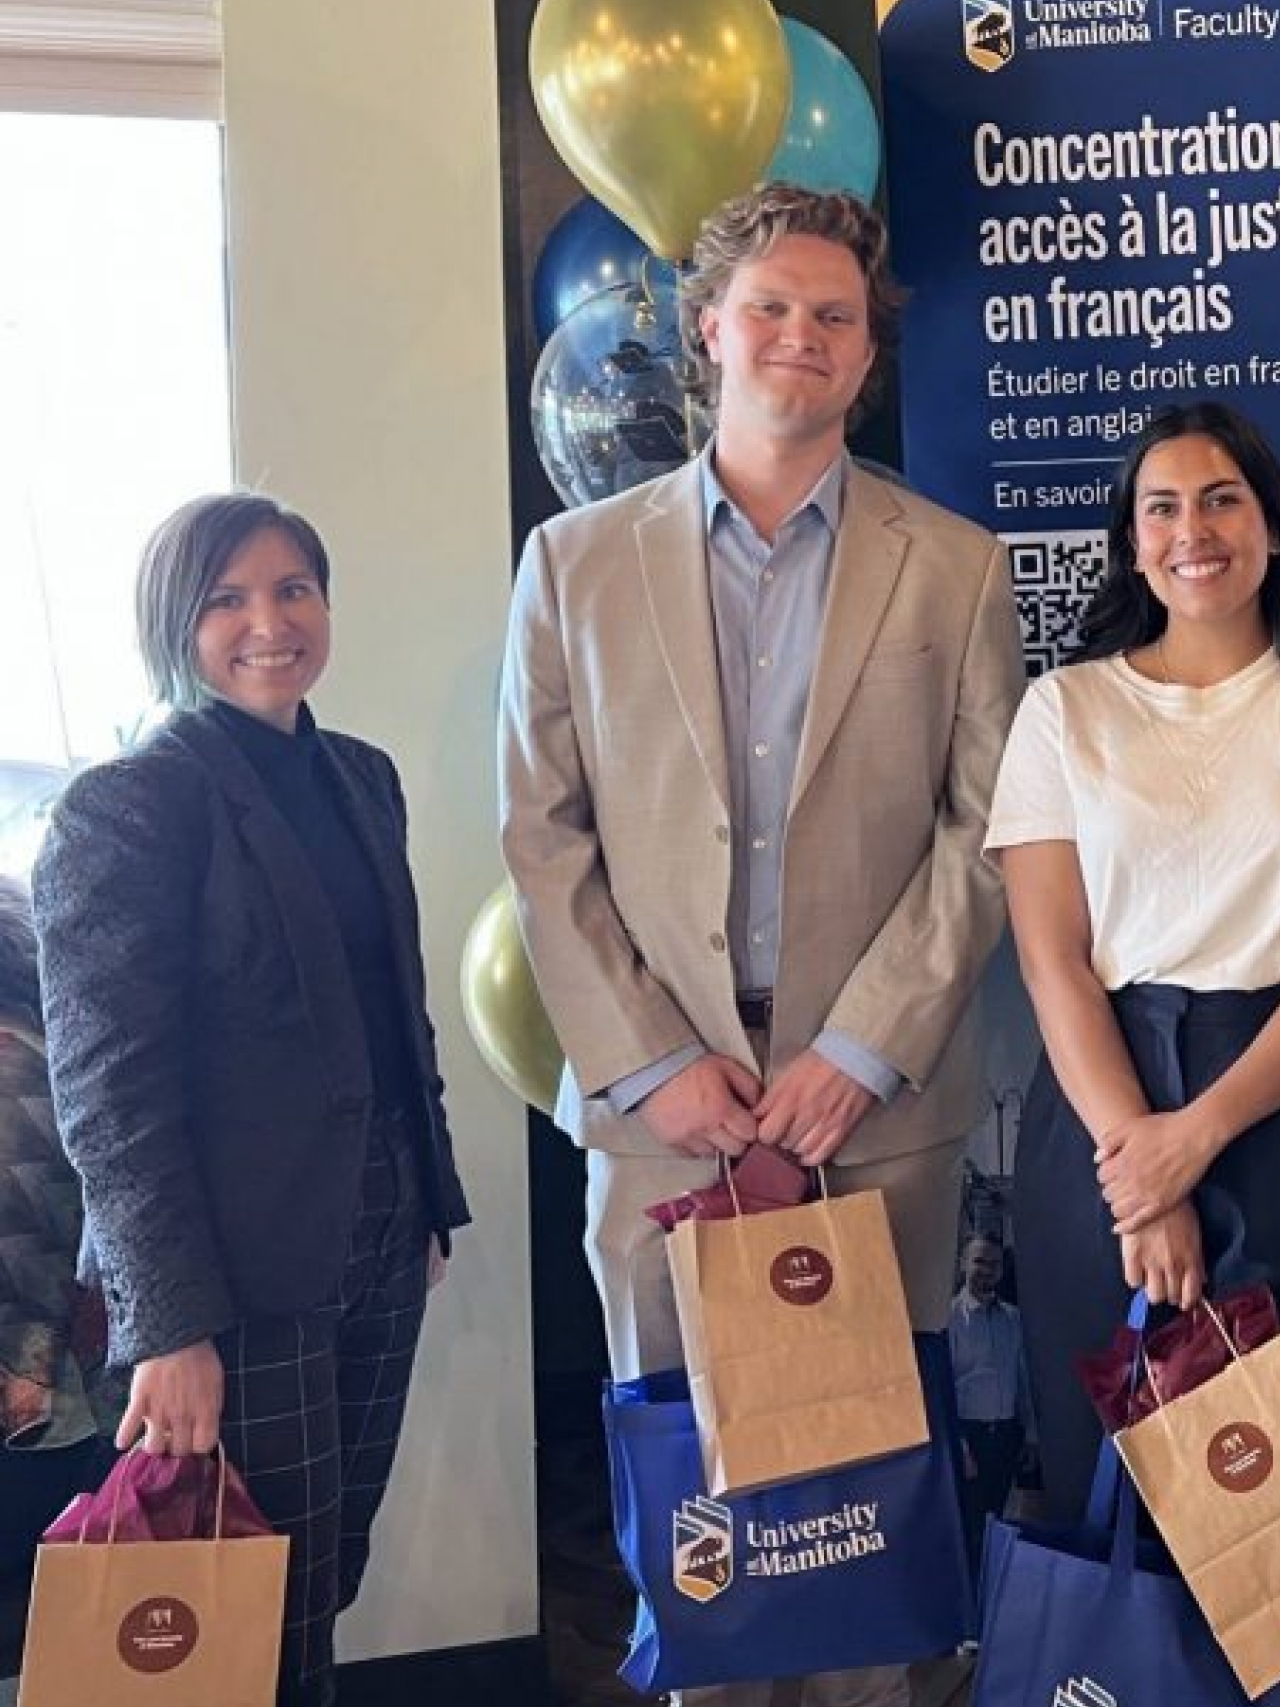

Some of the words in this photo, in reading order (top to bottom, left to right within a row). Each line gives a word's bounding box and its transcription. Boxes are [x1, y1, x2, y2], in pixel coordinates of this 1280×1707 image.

[1025, 0, 1149, 22] University
[1174, 5, 1280, 39] Faculty
[980, 198, 1106, 266] accès
[1120, 194, 1146, 259] à
[1158, 191, 1197, 255] la
[985, 294, 1037, 344] en
[1048, 267, 1233, 349] français
[988, 362, 1088, 397] Étudier
[1098, 364, 1121, 391] le
[1130, 358, 1197, 389] droit
[1204, 364, 1240, 386] en
[991, 411, 1017, 440] et
[1025, 414, 1058, 437] en
[1068, 404, 1152, 441] anglai
[995, 482, 1030, 508] En
[1035, 478, 1112, 507] savoir
[747, 1501, 878, 1548] University
[760, 1531, 887, 1575] Manitoba
